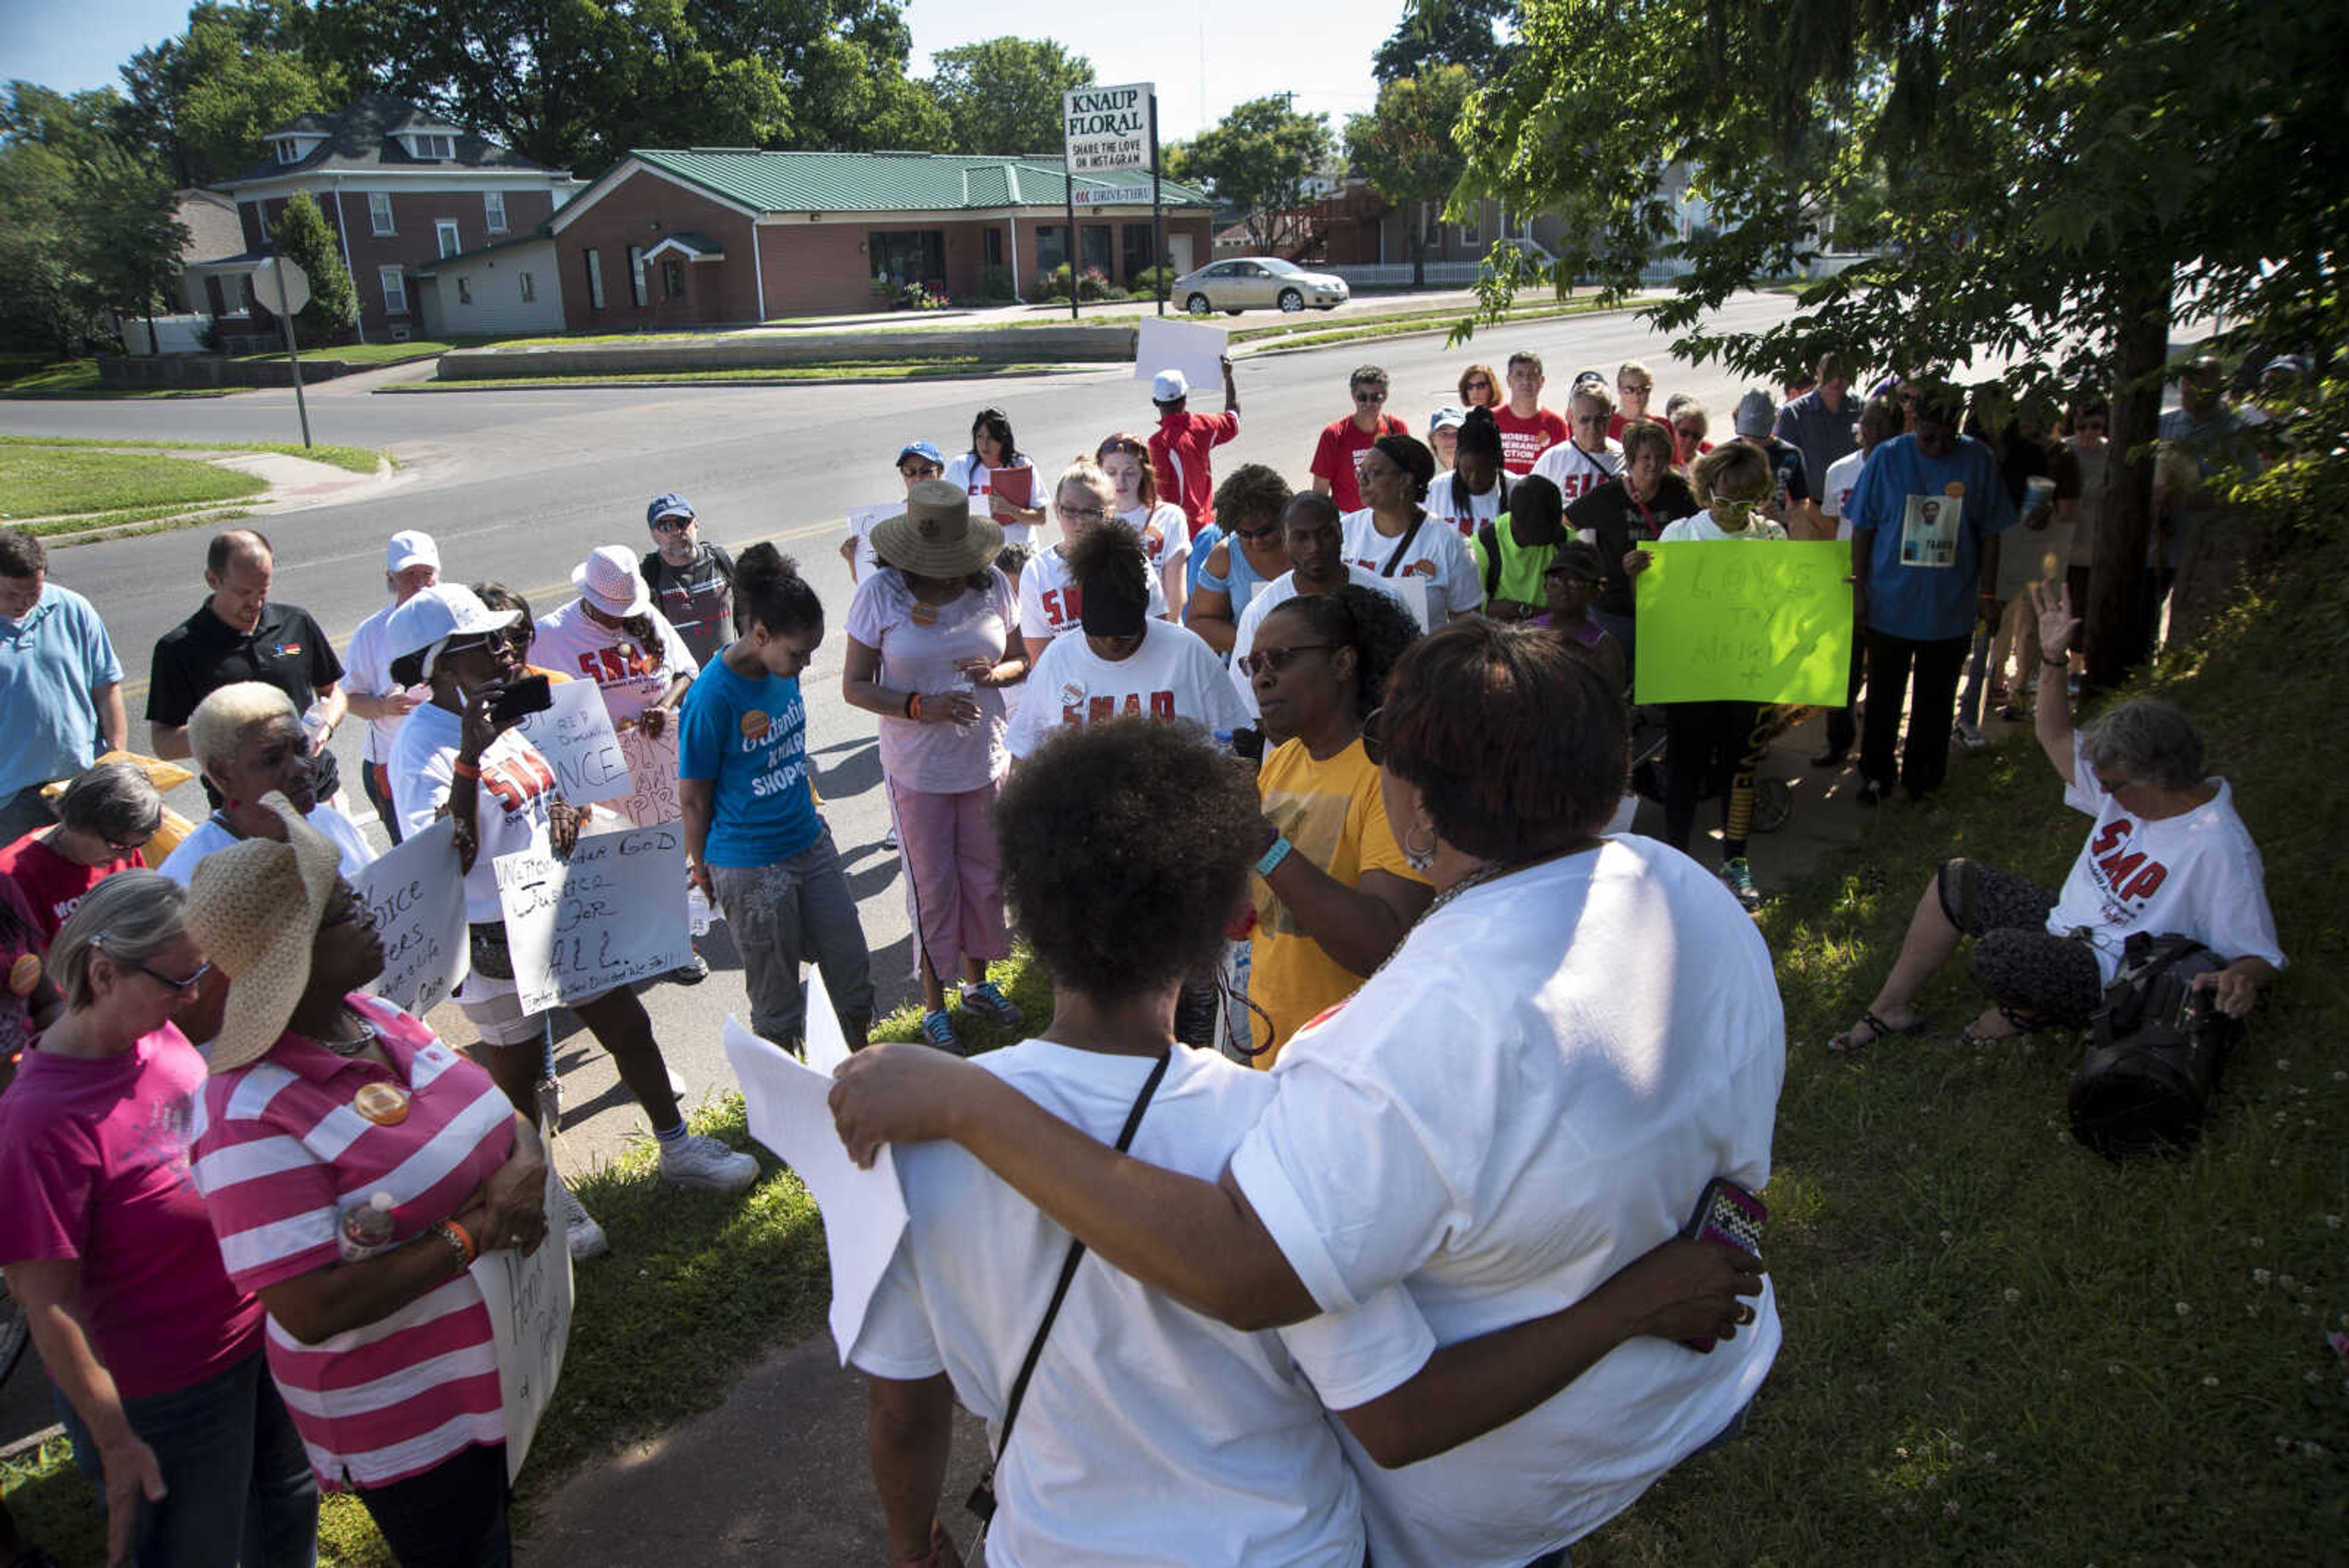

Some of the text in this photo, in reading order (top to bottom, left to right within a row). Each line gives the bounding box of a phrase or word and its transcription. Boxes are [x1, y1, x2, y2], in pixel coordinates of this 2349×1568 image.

[1072, 89, 1137, 113] KNAUP
[1069, 113, 1143, 136] FLORAL
[1073, 139, 1140, 155] SHARE THE LOVE
[1076, 154, 1140, 168] ON INSTAGRAM
[1094, 187, 1151, 202] DRIVE-THRU
[1504, 450, 1535, 459] CTION
